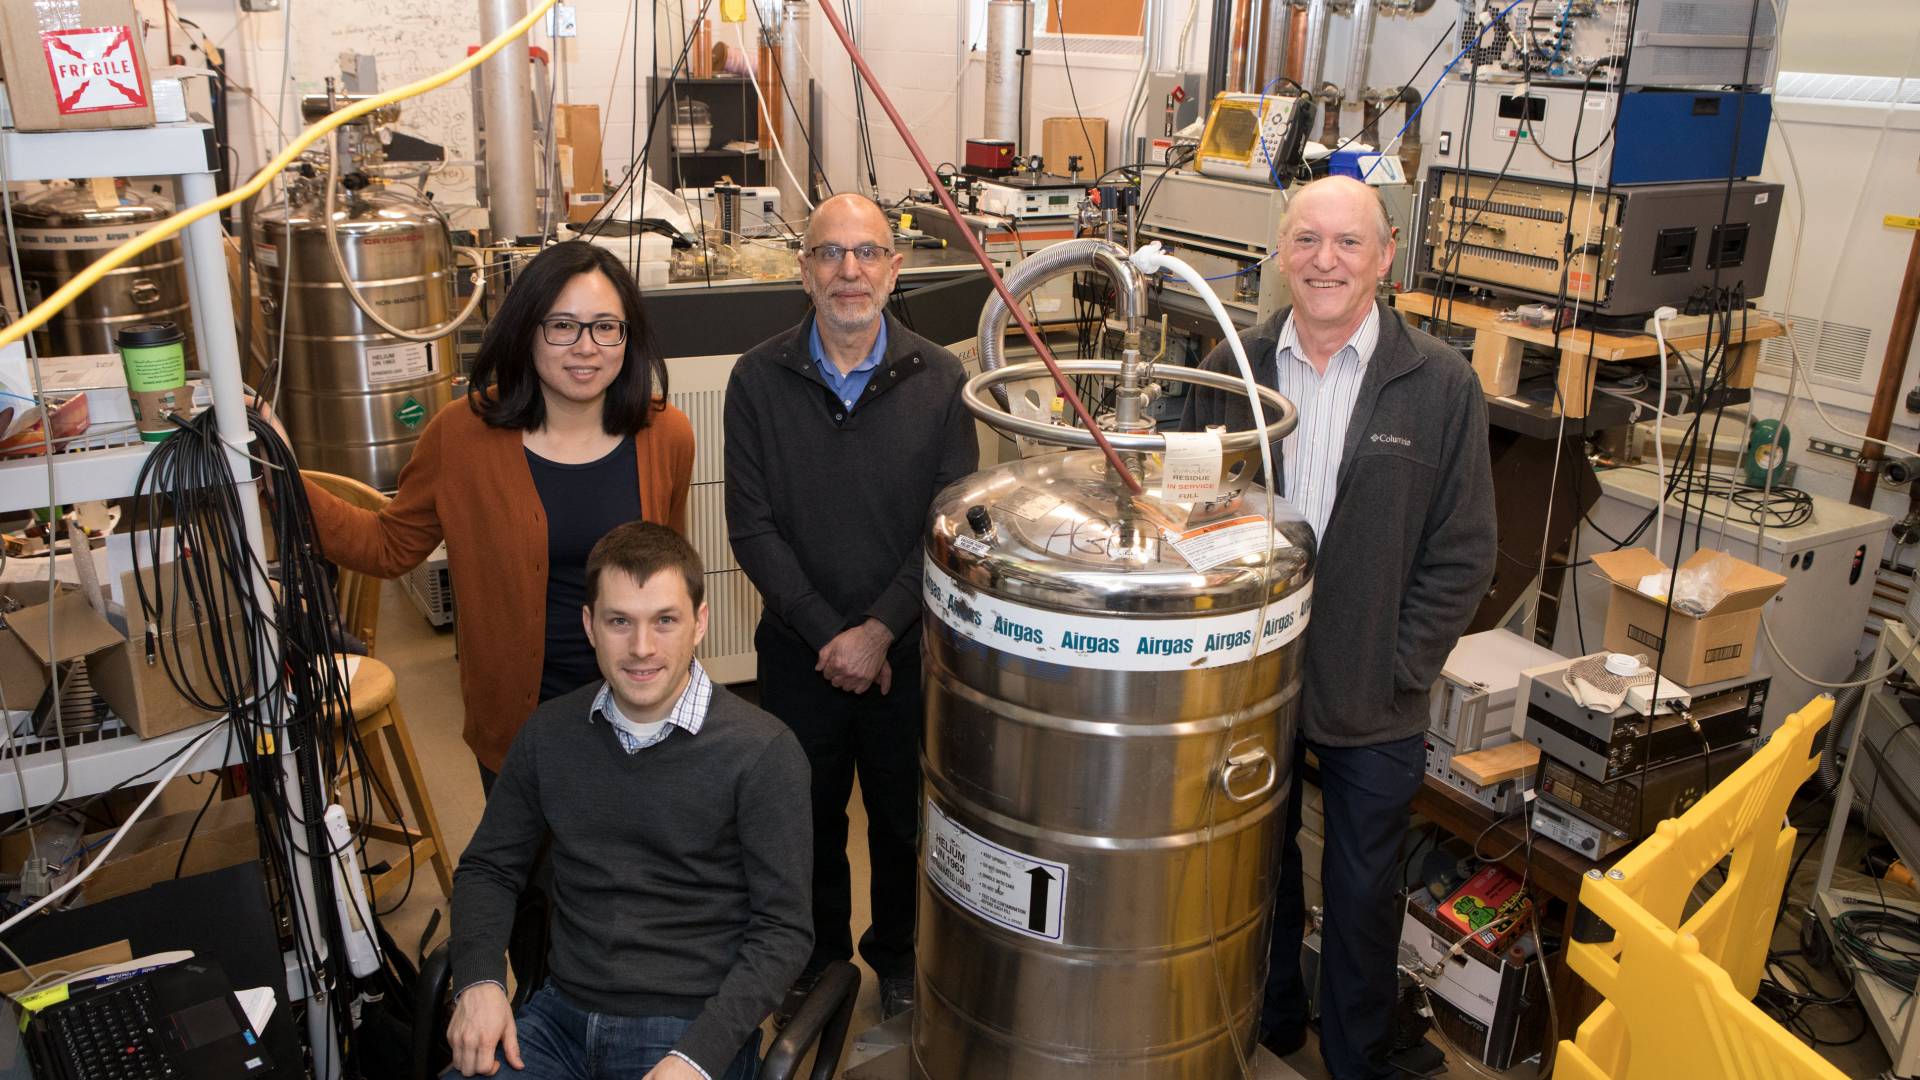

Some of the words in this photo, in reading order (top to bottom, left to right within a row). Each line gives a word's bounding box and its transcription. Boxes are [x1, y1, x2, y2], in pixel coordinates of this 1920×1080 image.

[947, 593, 982, 627] Ais
[993, 615, 1044, 645] Airgas
[1061, 631, 1120, 653] Airgas
[1136, 636, 1194, 656] Airgas
[1204, 629, 1251, 652] Airgas
[1263, 611, 1294, 638] Airgas
[935, 844, 945, 861] UN
[946, 855, 965, 876] 1963
[936, 831, 966, 864] HELIUM
